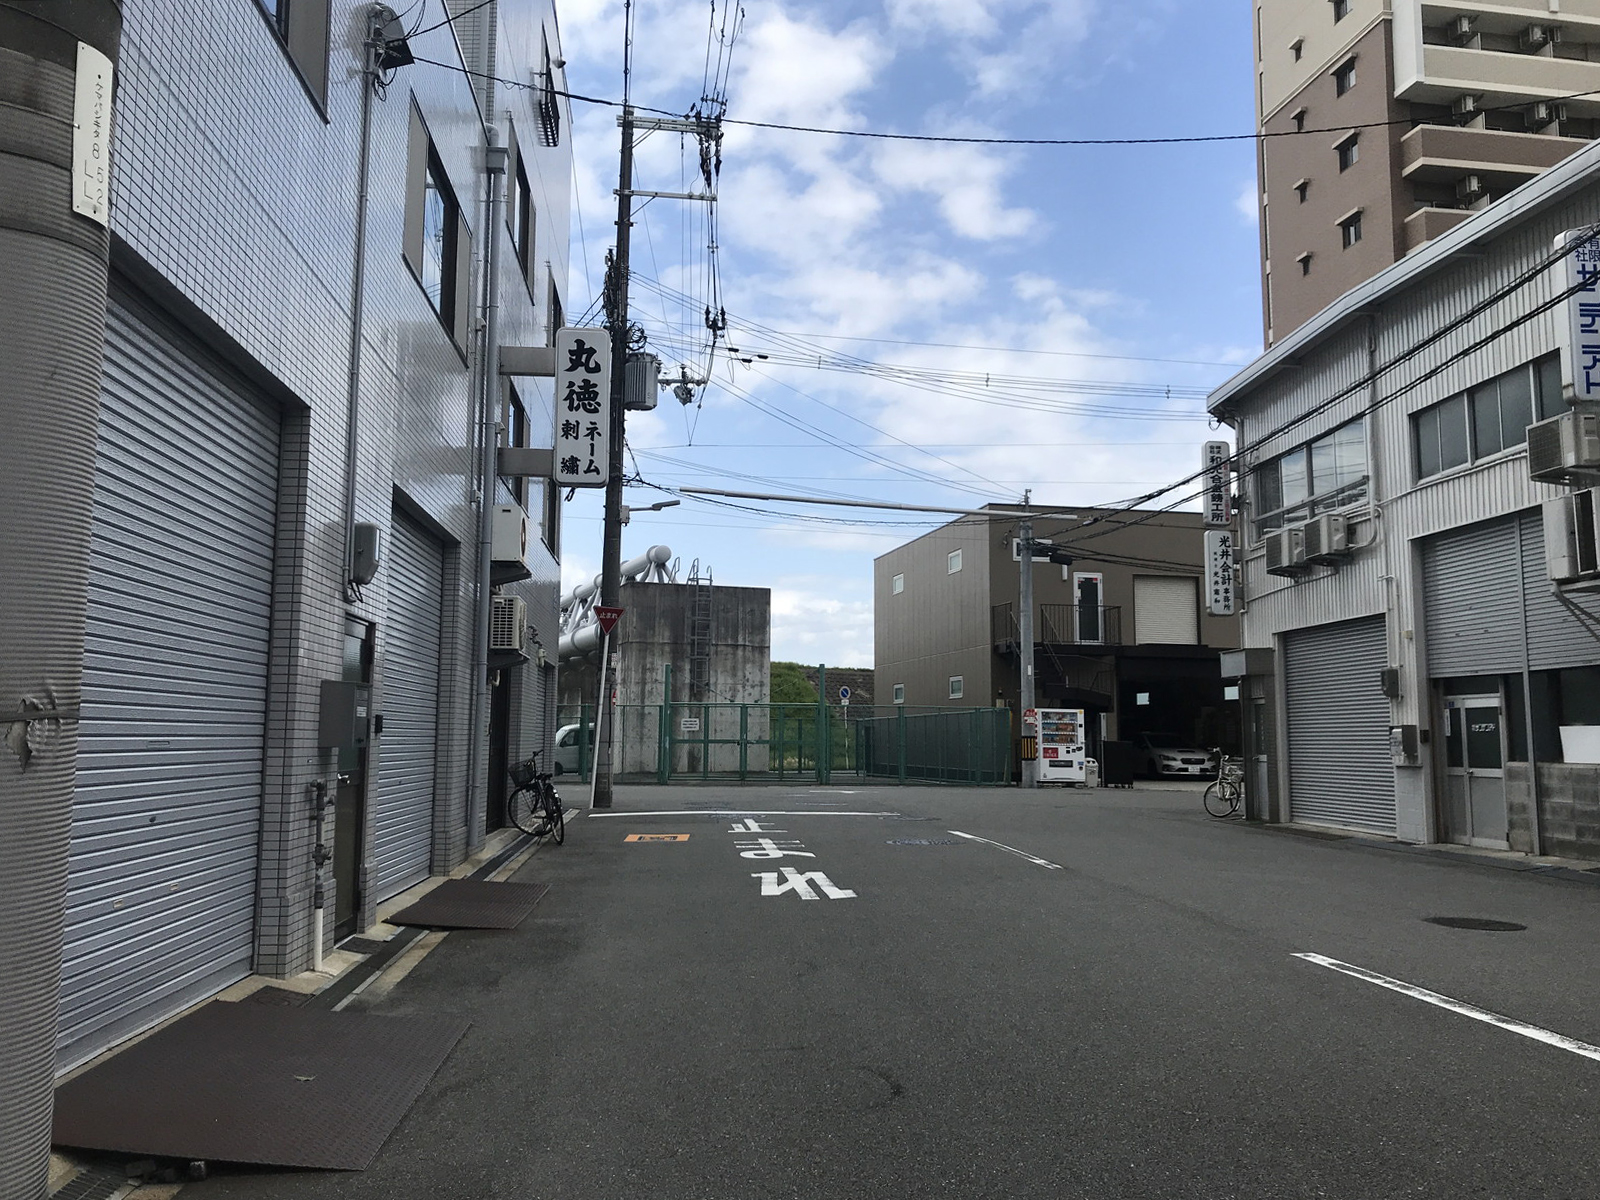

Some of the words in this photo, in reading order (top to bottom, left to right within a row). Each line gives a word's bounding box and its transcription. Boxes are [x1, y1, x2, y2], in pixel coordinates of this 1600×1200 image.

[563, 338, 602, 414] 丸徳
[583, 421, 602, 476] ネーム
[599, 611, 618, 620] 止まれ
[727, 818, 858, 900] 止まれ
